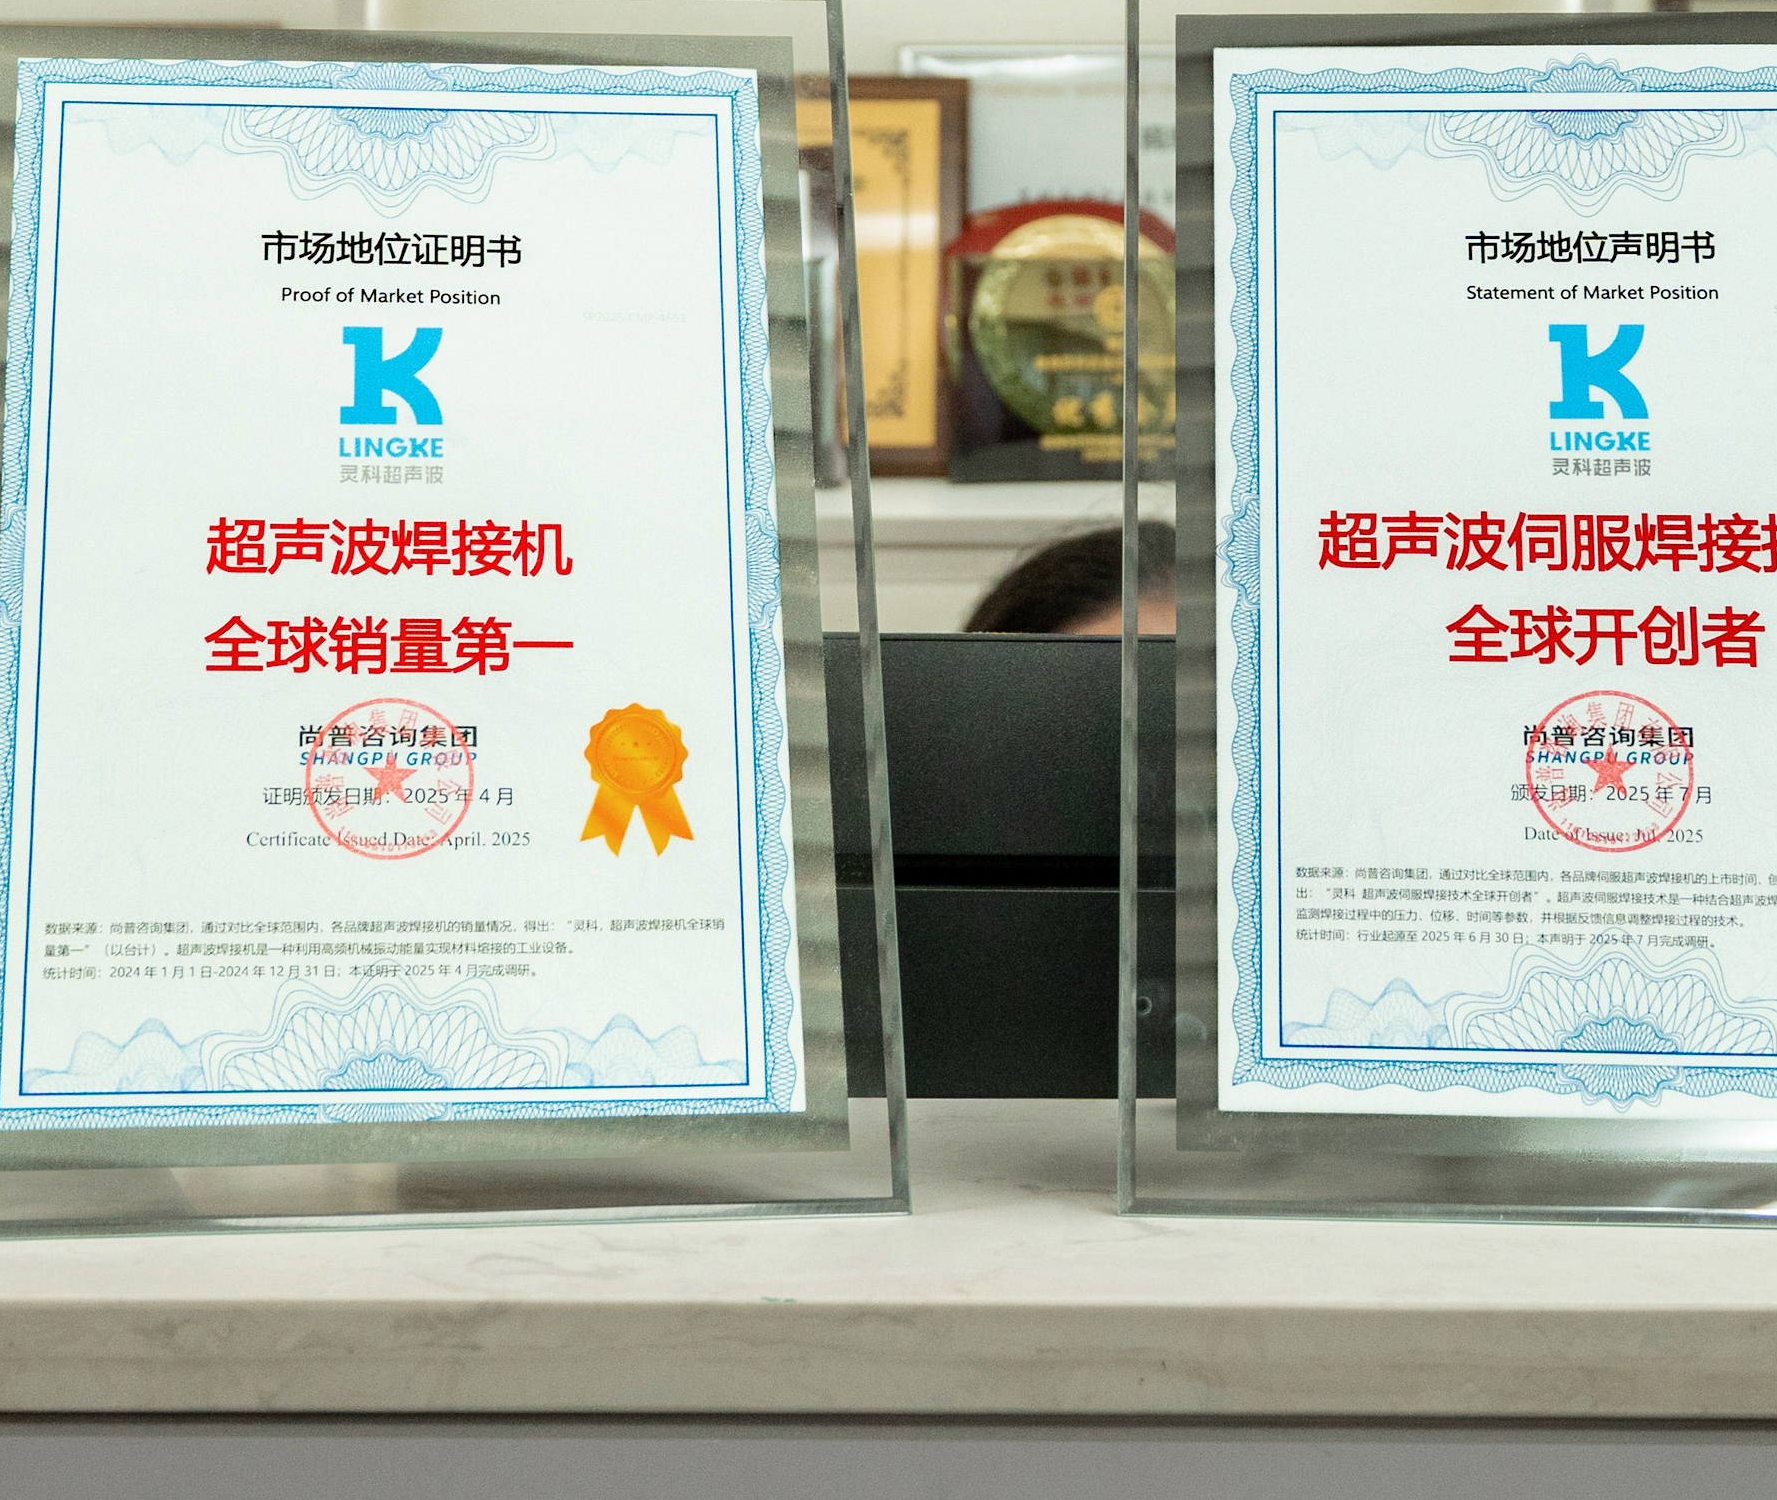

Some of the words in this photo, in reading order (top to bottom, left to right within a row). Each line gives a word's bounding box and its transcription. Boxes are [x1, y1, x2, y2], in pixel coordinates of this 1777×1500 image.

[261, 229, 522, 268] 市场地位证明书
[1465, 230, 1715, 264] 市场地位声明书
[282, 287, 331, 303] Proof
[336, 287, 355, 303] of
[361, 288, 424, 304] Market
[430, 289, 501, 305] Position
[1466, 285, 1555, 300] Statement
[1561, 284, 1578, 300] of
[1583, 285, 1644, 300] Market
[1650, 285, 1719, 300] Position
[339, 437, 444, 458] LINGKE
[1550, 431, 1651, 451] LINGKE
[339, 464, 444, 485] 灵科超声波
[1552, 457, 1652, 477] 灵科超声波
[206, 517, 573, 577] 超声波焊接机
[204, 615, 574, 676] 全球销量第一
[1445, 604, 1766, 668] 全球开创者
[299, 725, 478, 748] 尚普咨询集团
[1523, 725, 1695, 747] 尚普咨询集团
[247, 831, 330, 848] Certificate
[337, 831, 387, 847] Issued
[491, 832, 530, 848] 2025
[1524, 826, 1559, 841] Date
[1666, 828, 1704, 843] 2025
